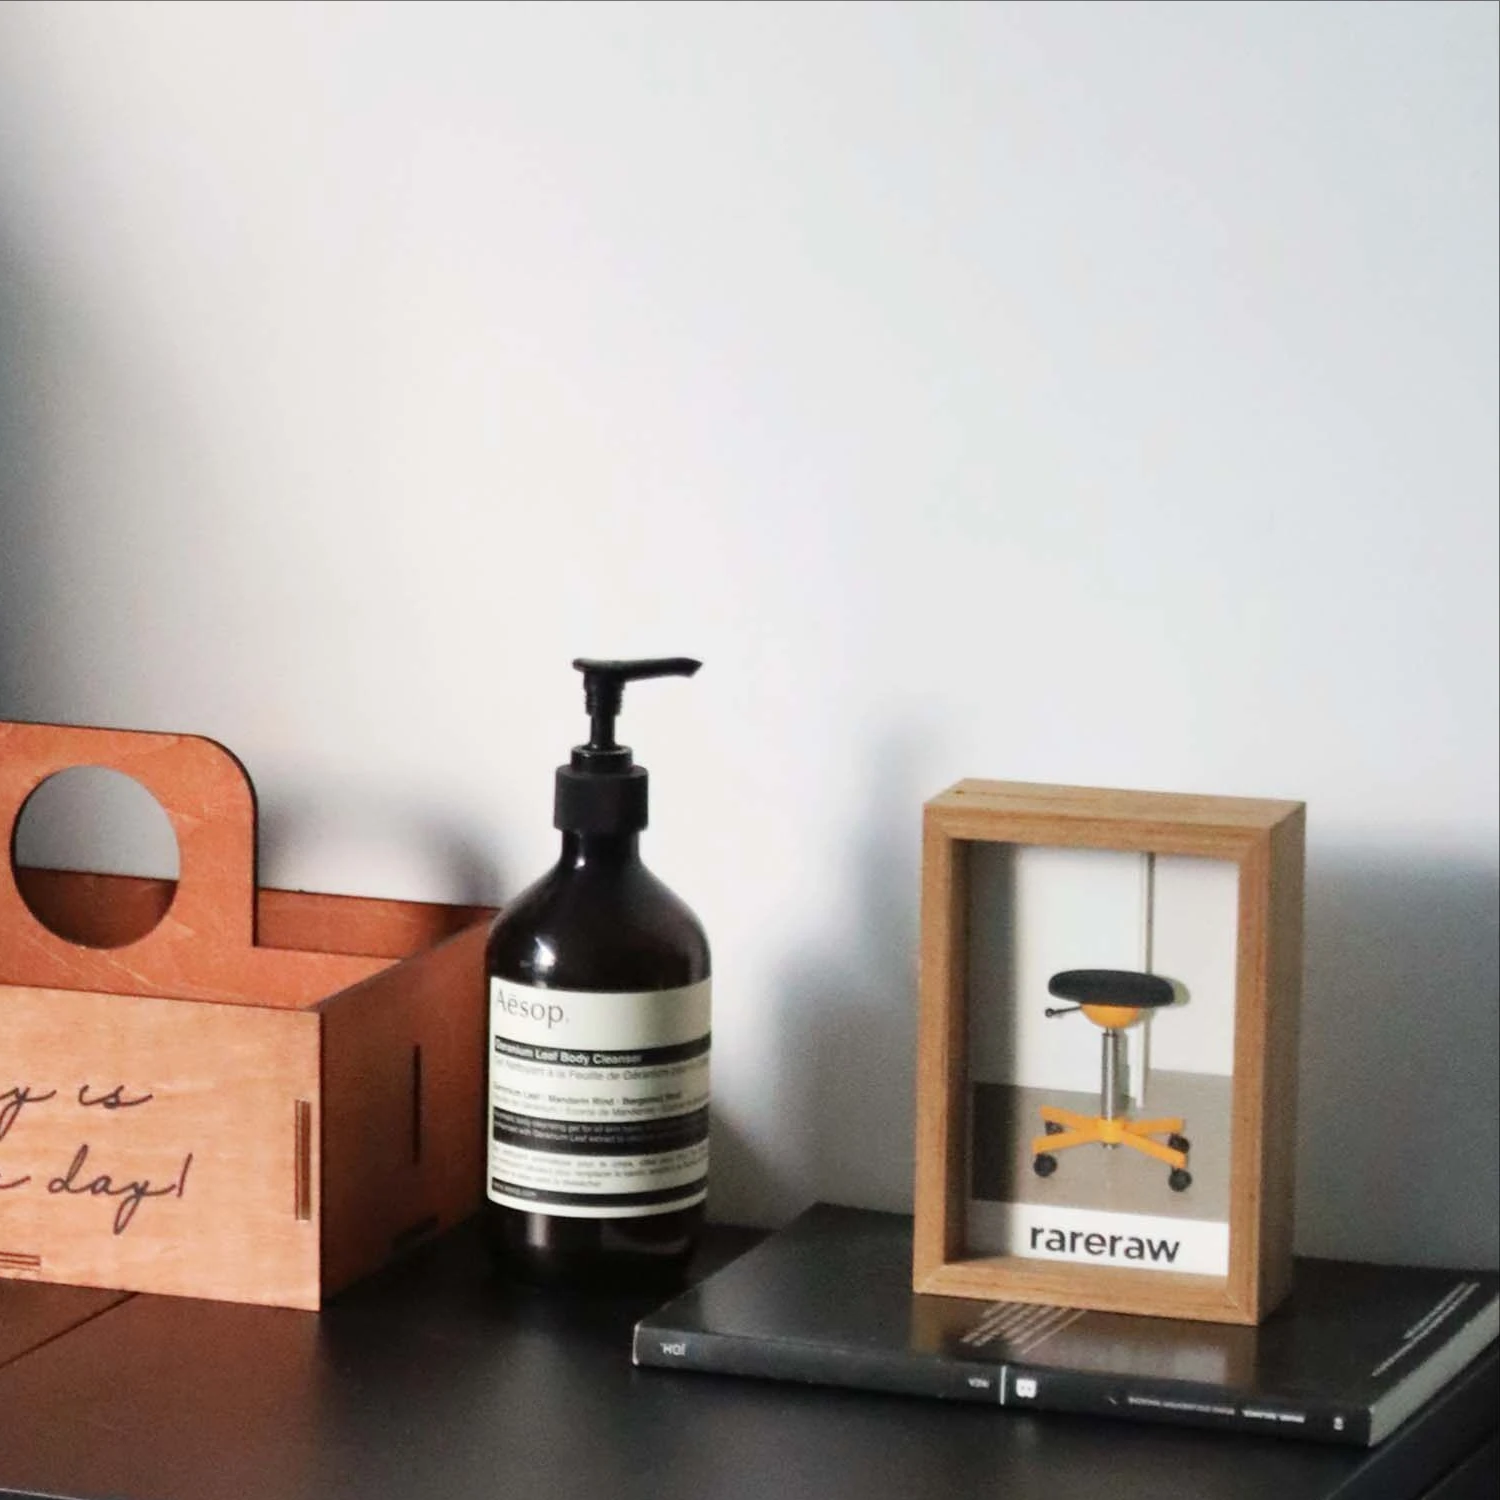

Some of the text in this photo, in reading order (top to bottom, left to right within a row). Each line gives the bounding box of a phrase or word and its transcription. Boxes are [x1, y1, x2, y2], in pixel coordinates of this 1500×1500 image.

[559, 1050, 590, 1066] Body
[592, 1052, 643, 1065] Cleanser
[78, 1083, 154, 1109] is
[49, 1144, 193, 1235] day!
[1030, 1226, 1180, 1264] rareraw
